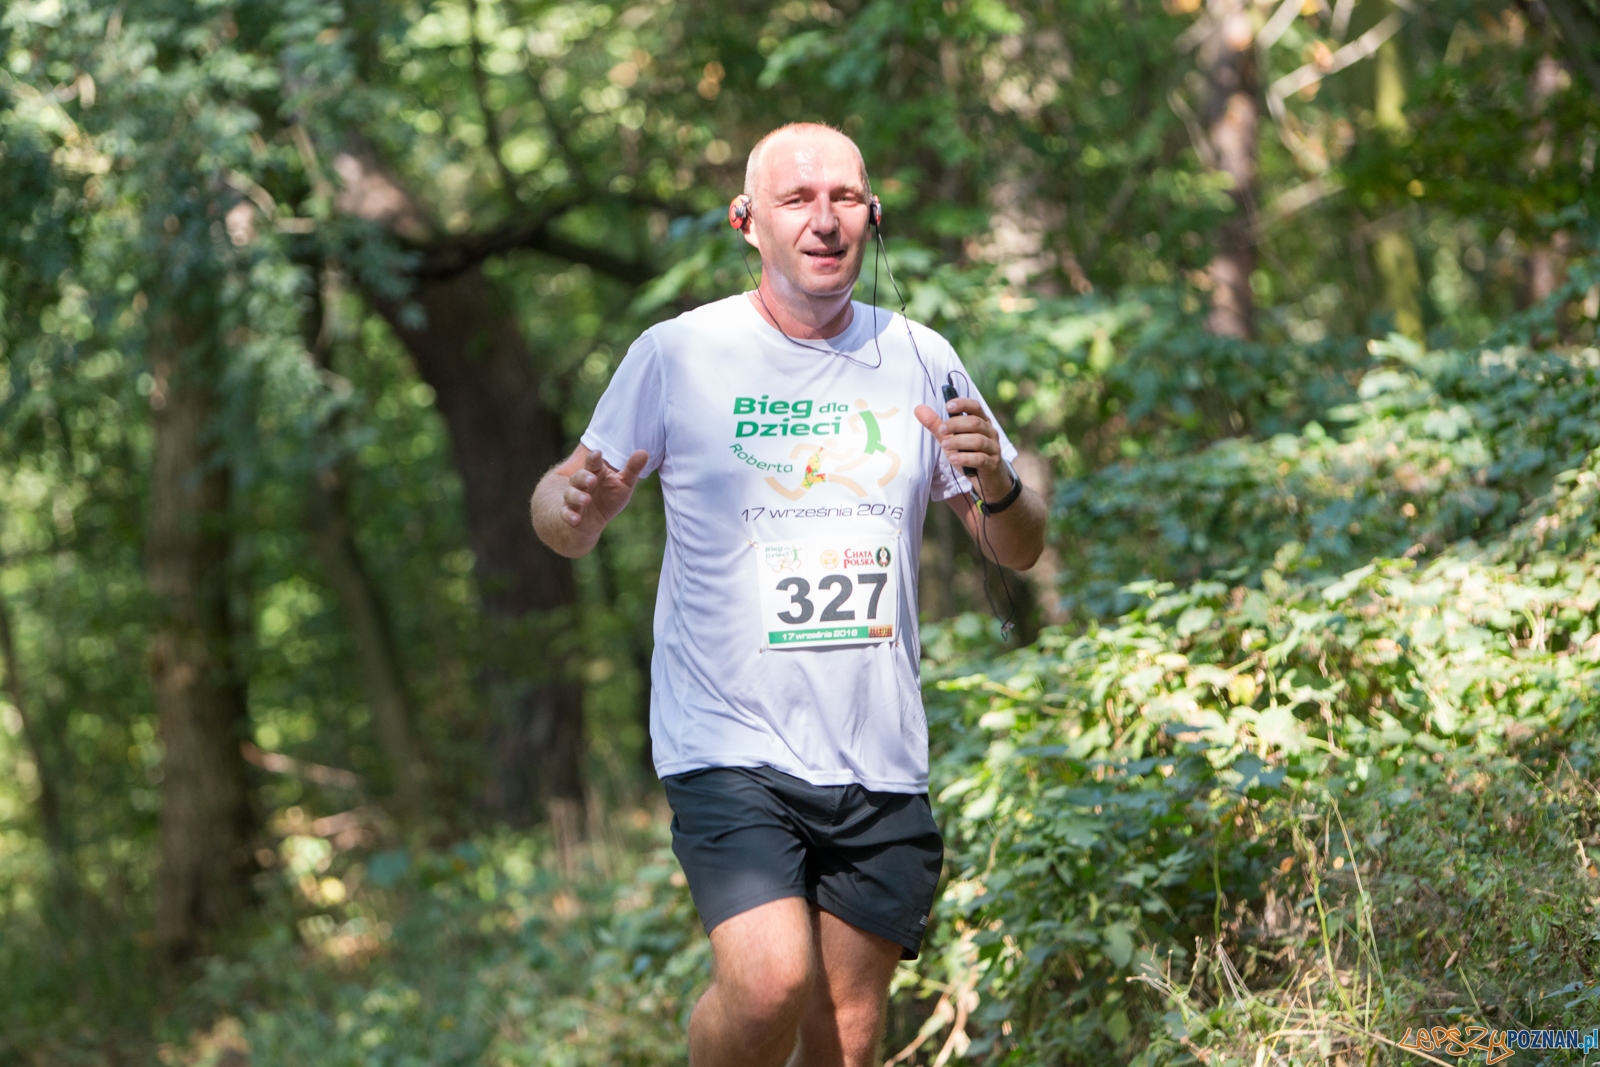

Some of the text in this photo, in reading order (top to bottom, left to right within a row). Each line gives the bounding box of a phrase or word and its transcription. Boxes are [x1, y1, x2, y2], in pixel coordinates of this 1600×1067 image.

[733, 395, 849, 419] Bieg dla
[735, 416, 842, 438] Dzieci
[729, 443, 794, 474] Roberta
[741, 507, 766, 522] 17
[769, 505, 853, 519] września
[844, 548, 873, 559] CHATA
[843, 558, 875, 569] POLSKA
[775, 572, 888, 625] 327
[782, 633, 795, 641] 17
